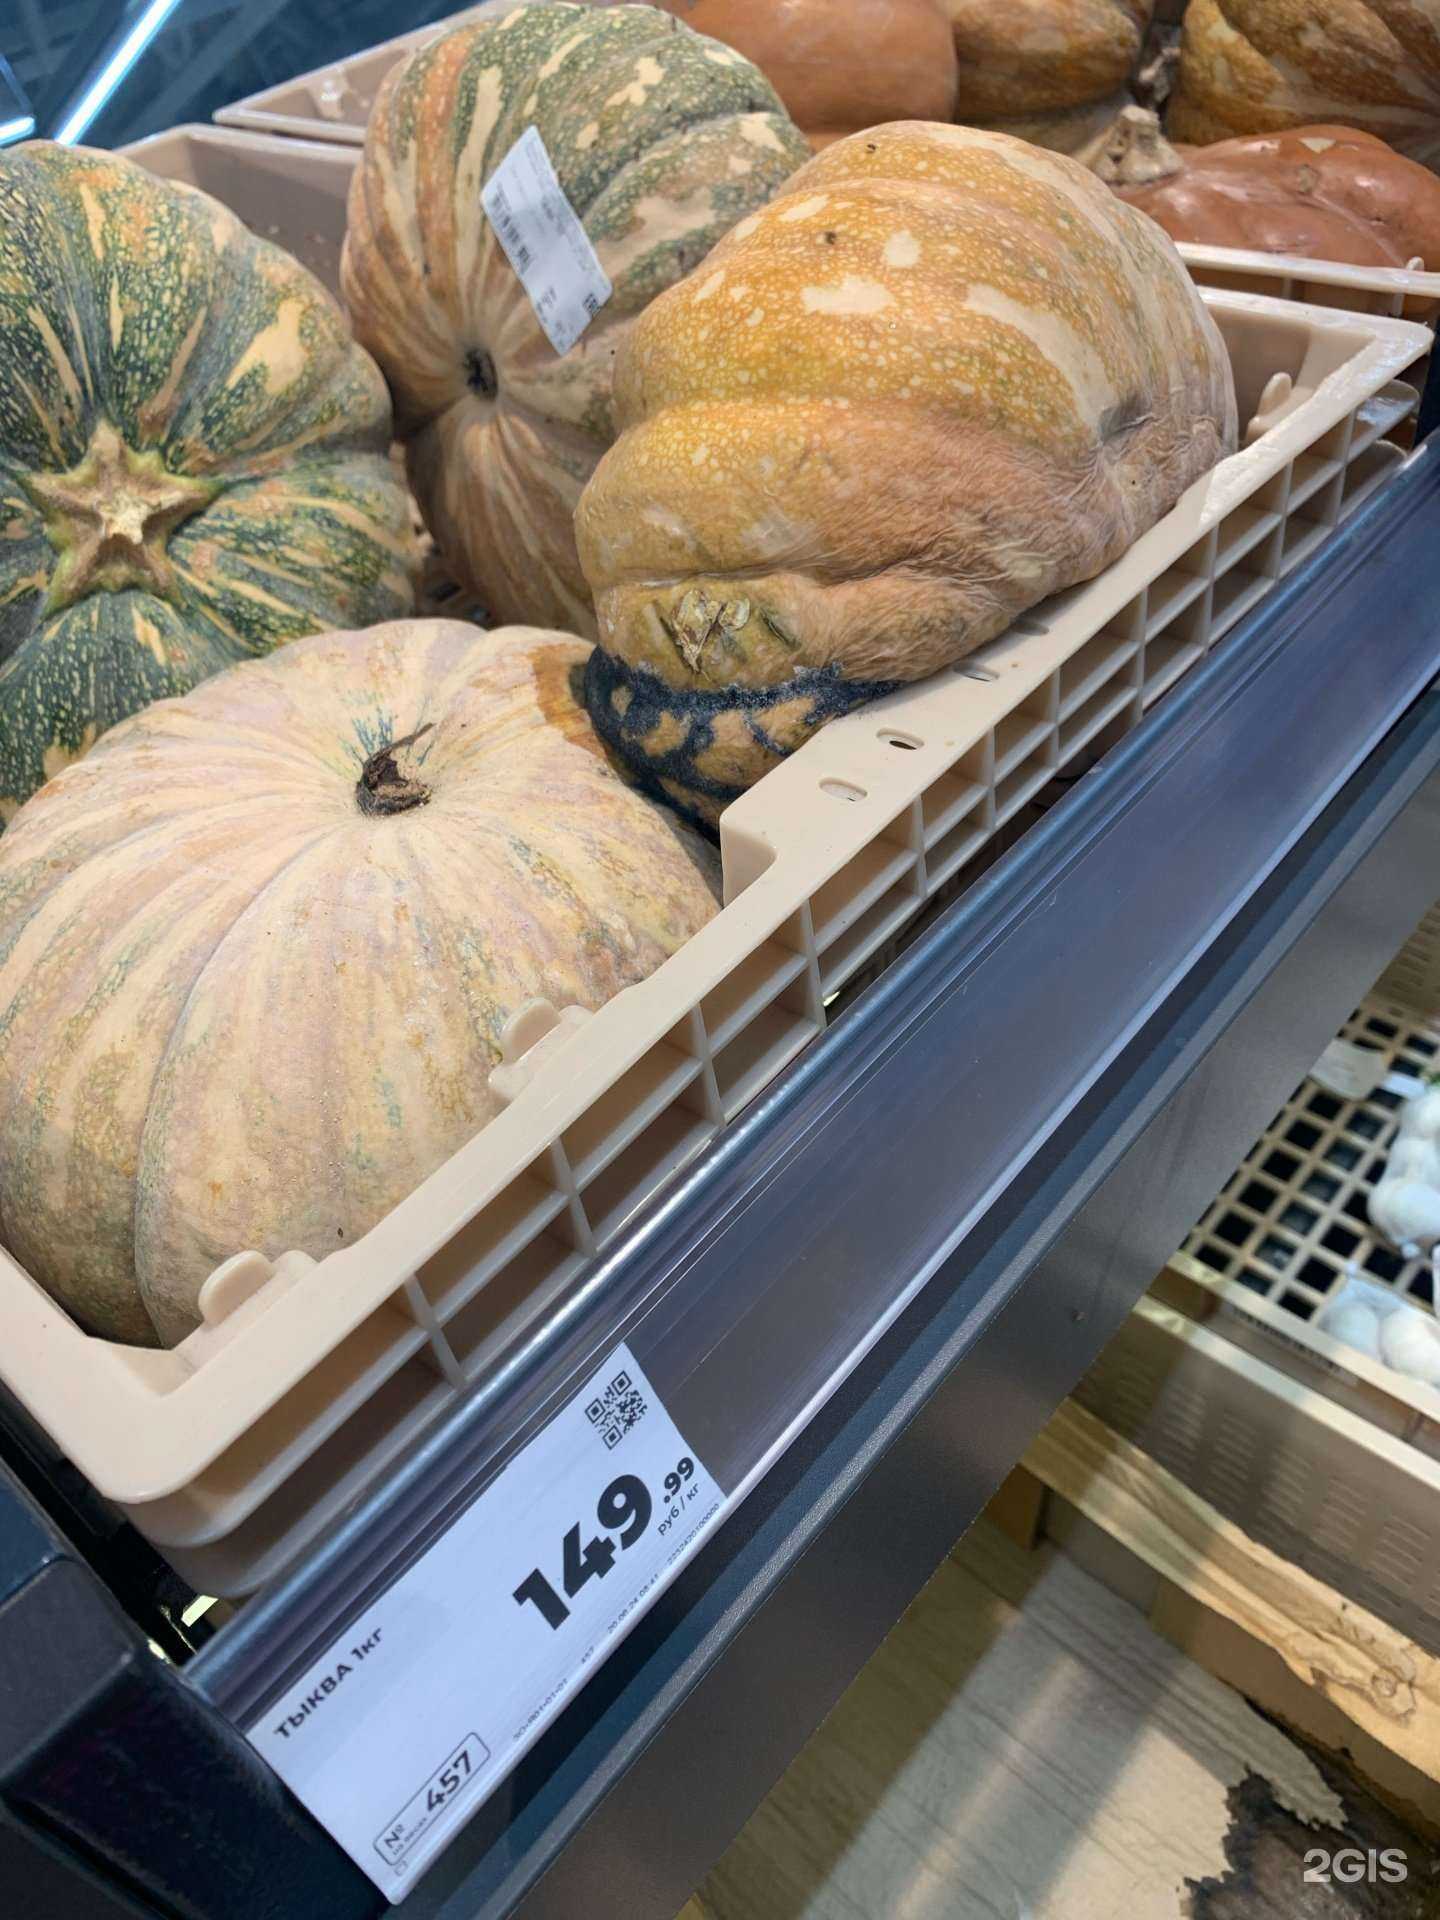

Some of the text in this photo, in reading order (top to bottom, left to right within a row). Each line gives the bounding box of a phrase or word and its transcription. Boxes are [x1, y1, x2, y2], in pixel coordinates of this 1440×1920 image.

[657, 1505, 680, 1537] руб
[686, 1482, 700, 1501] кг
[273, 1626, 383, 1739] ТЫКВА 1кг
[425, 1748, 472, 1813] 457
